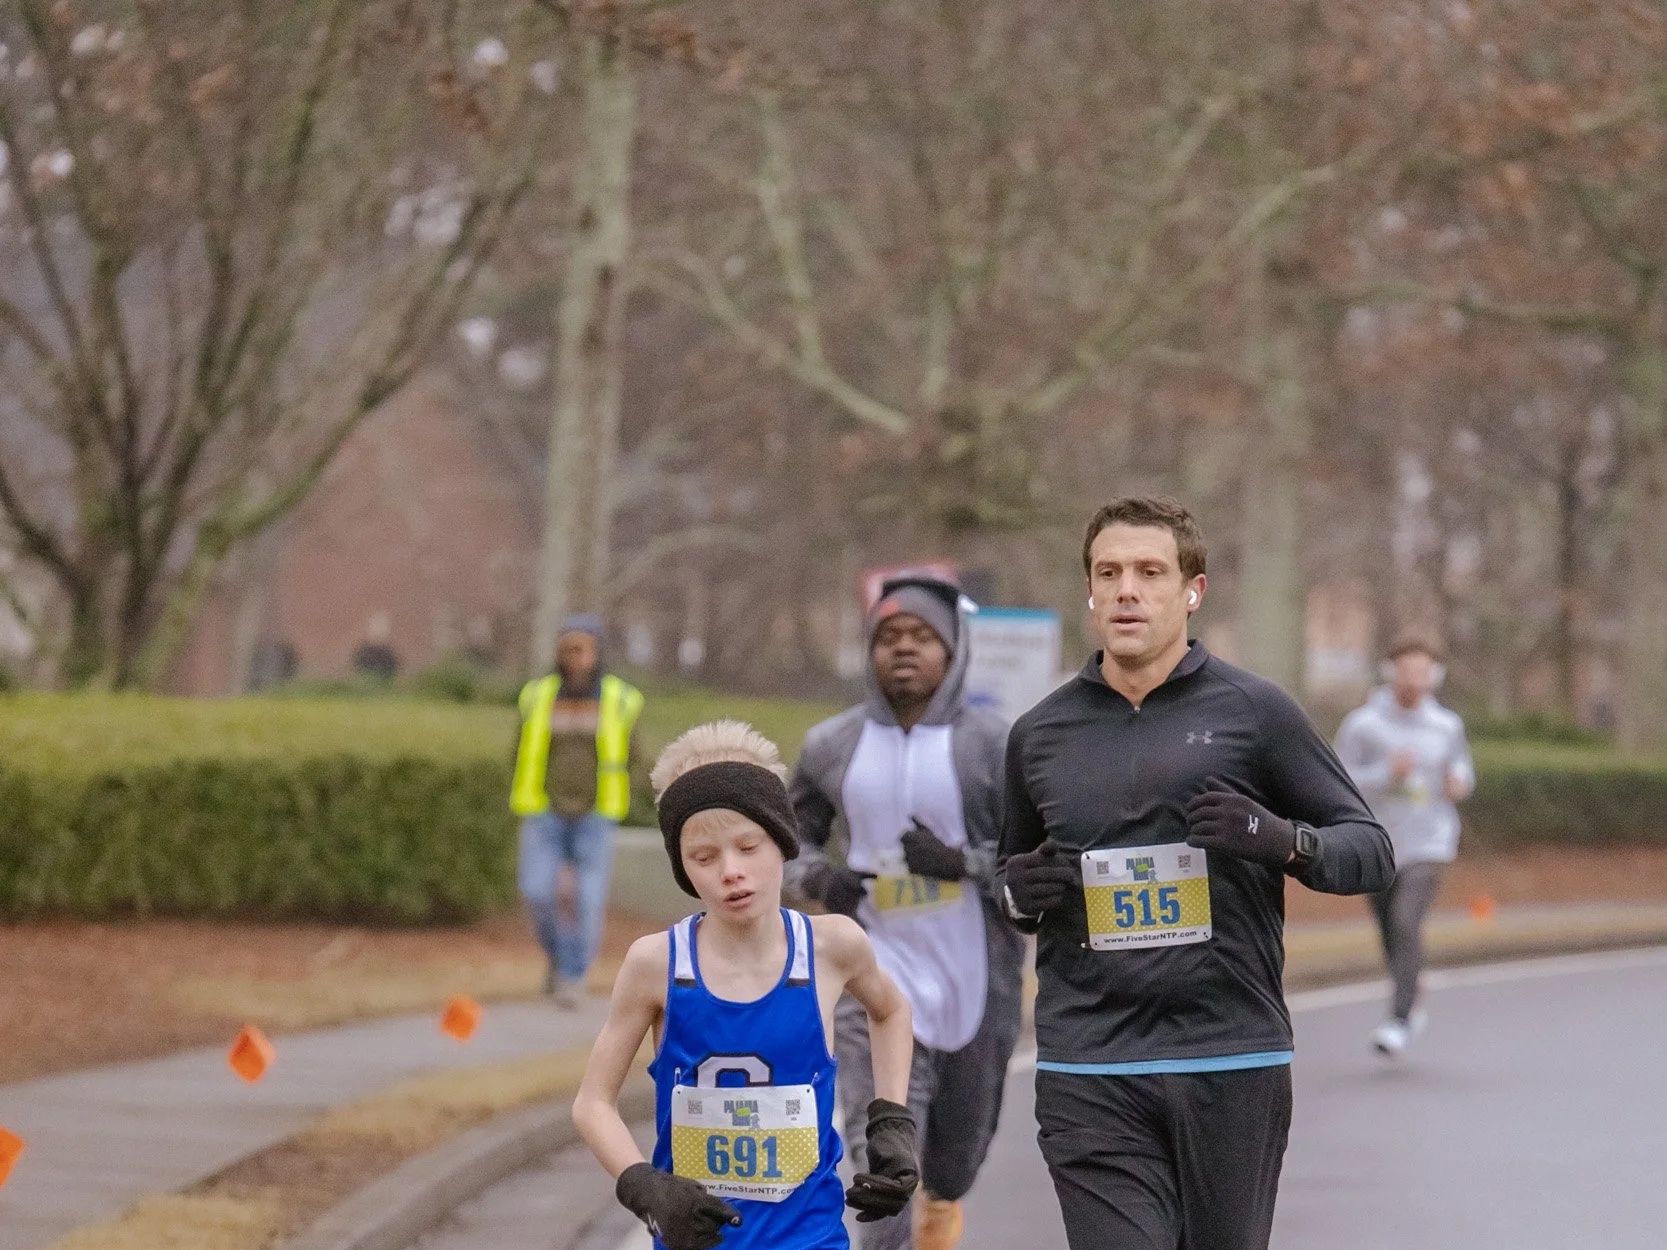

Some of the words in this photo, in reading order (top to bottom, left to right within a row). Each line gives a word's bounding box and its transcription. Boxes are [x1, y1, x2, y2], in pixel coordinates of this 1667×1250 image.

[1113, 886, 1181, 929] 515
[1103, 930, 1198, 944] www.FiveStarNTP.com
[706, 1134, 783, 1178] 691
